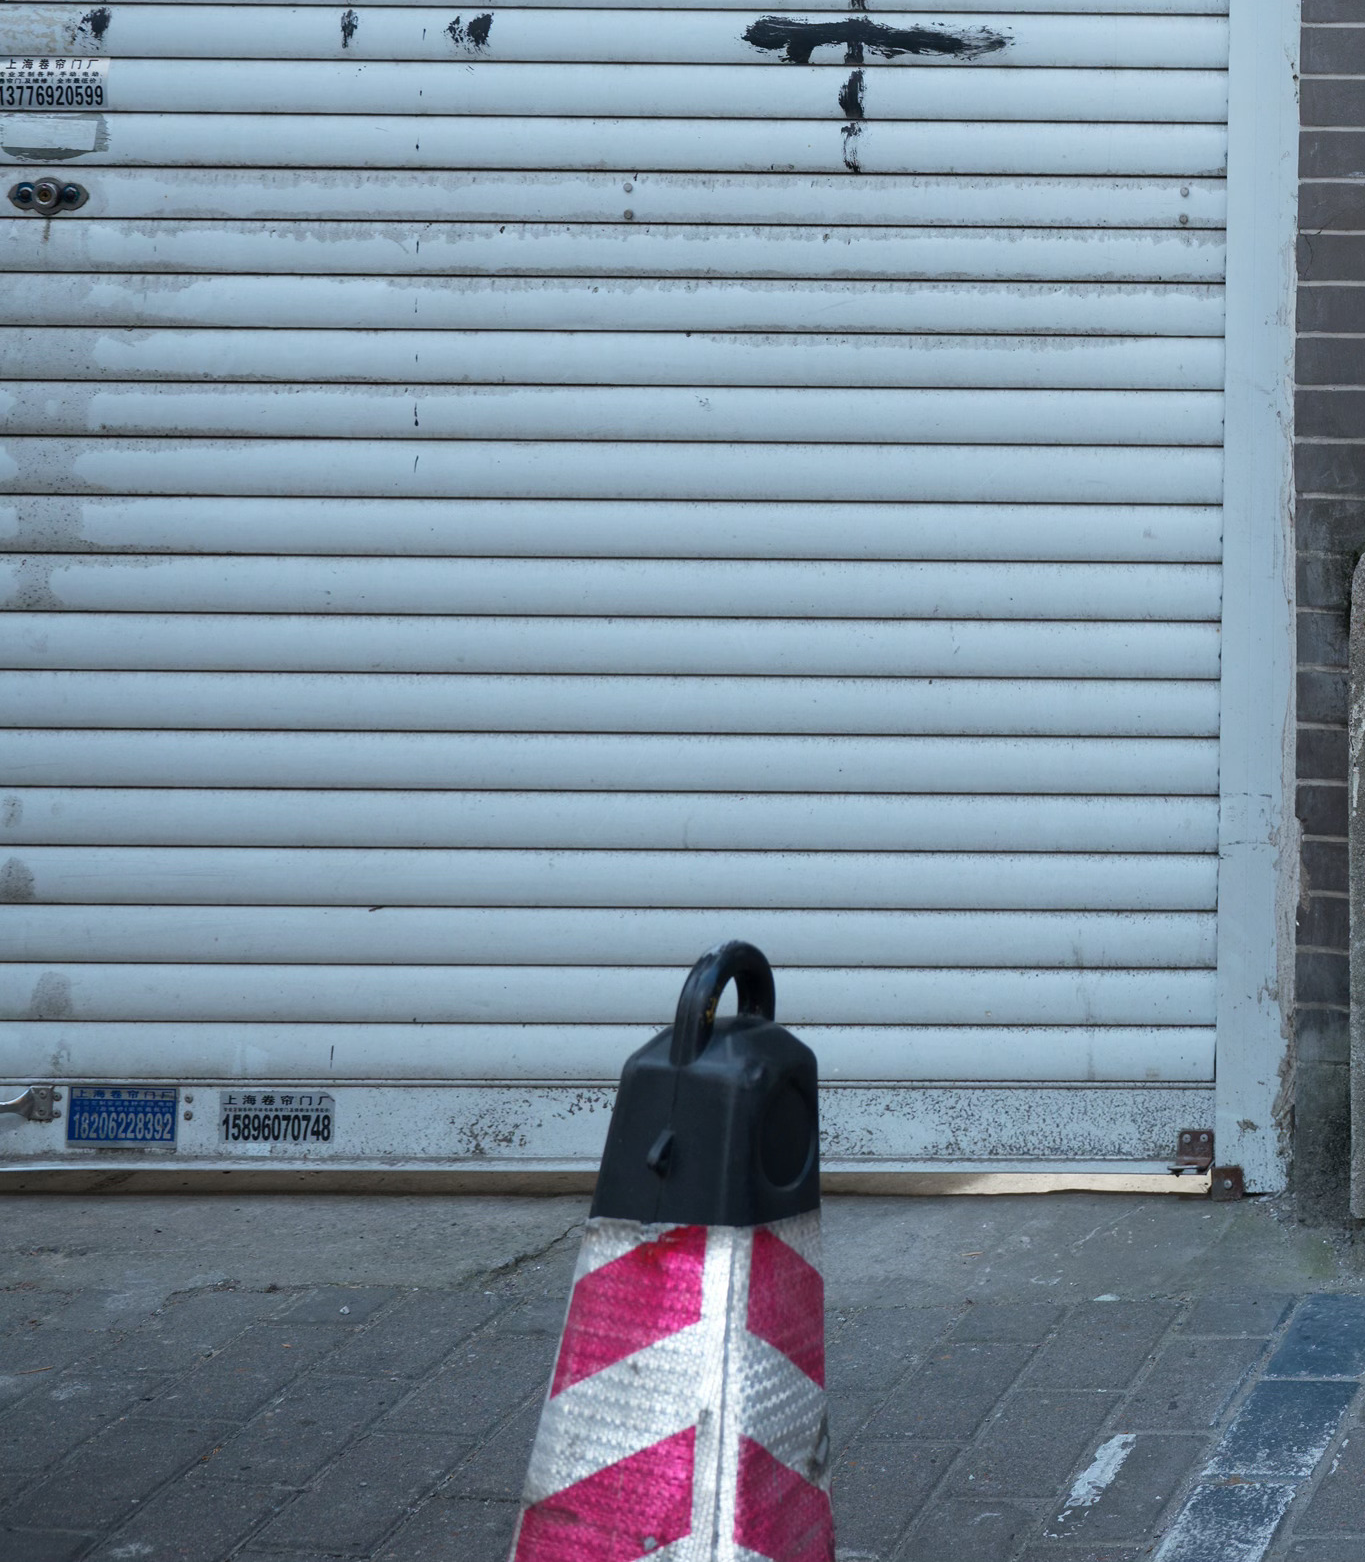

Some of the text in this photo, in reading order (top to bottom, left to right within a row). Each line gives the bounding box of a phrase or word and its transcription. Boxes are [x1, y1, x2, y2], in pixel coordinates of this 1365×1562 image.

[6, 59, 99, 70] 上海卷帘门厂
[0, 85, 103, 106] 13776920599
[76, 1089, 173, 1099] 上海卷帘门厂
[223, 1095, 332, 1105] 上海卷帘门厂
[73, 1112, 172, 1139] 18206228392
[222, 1114, 331, 1141] 15896070748
